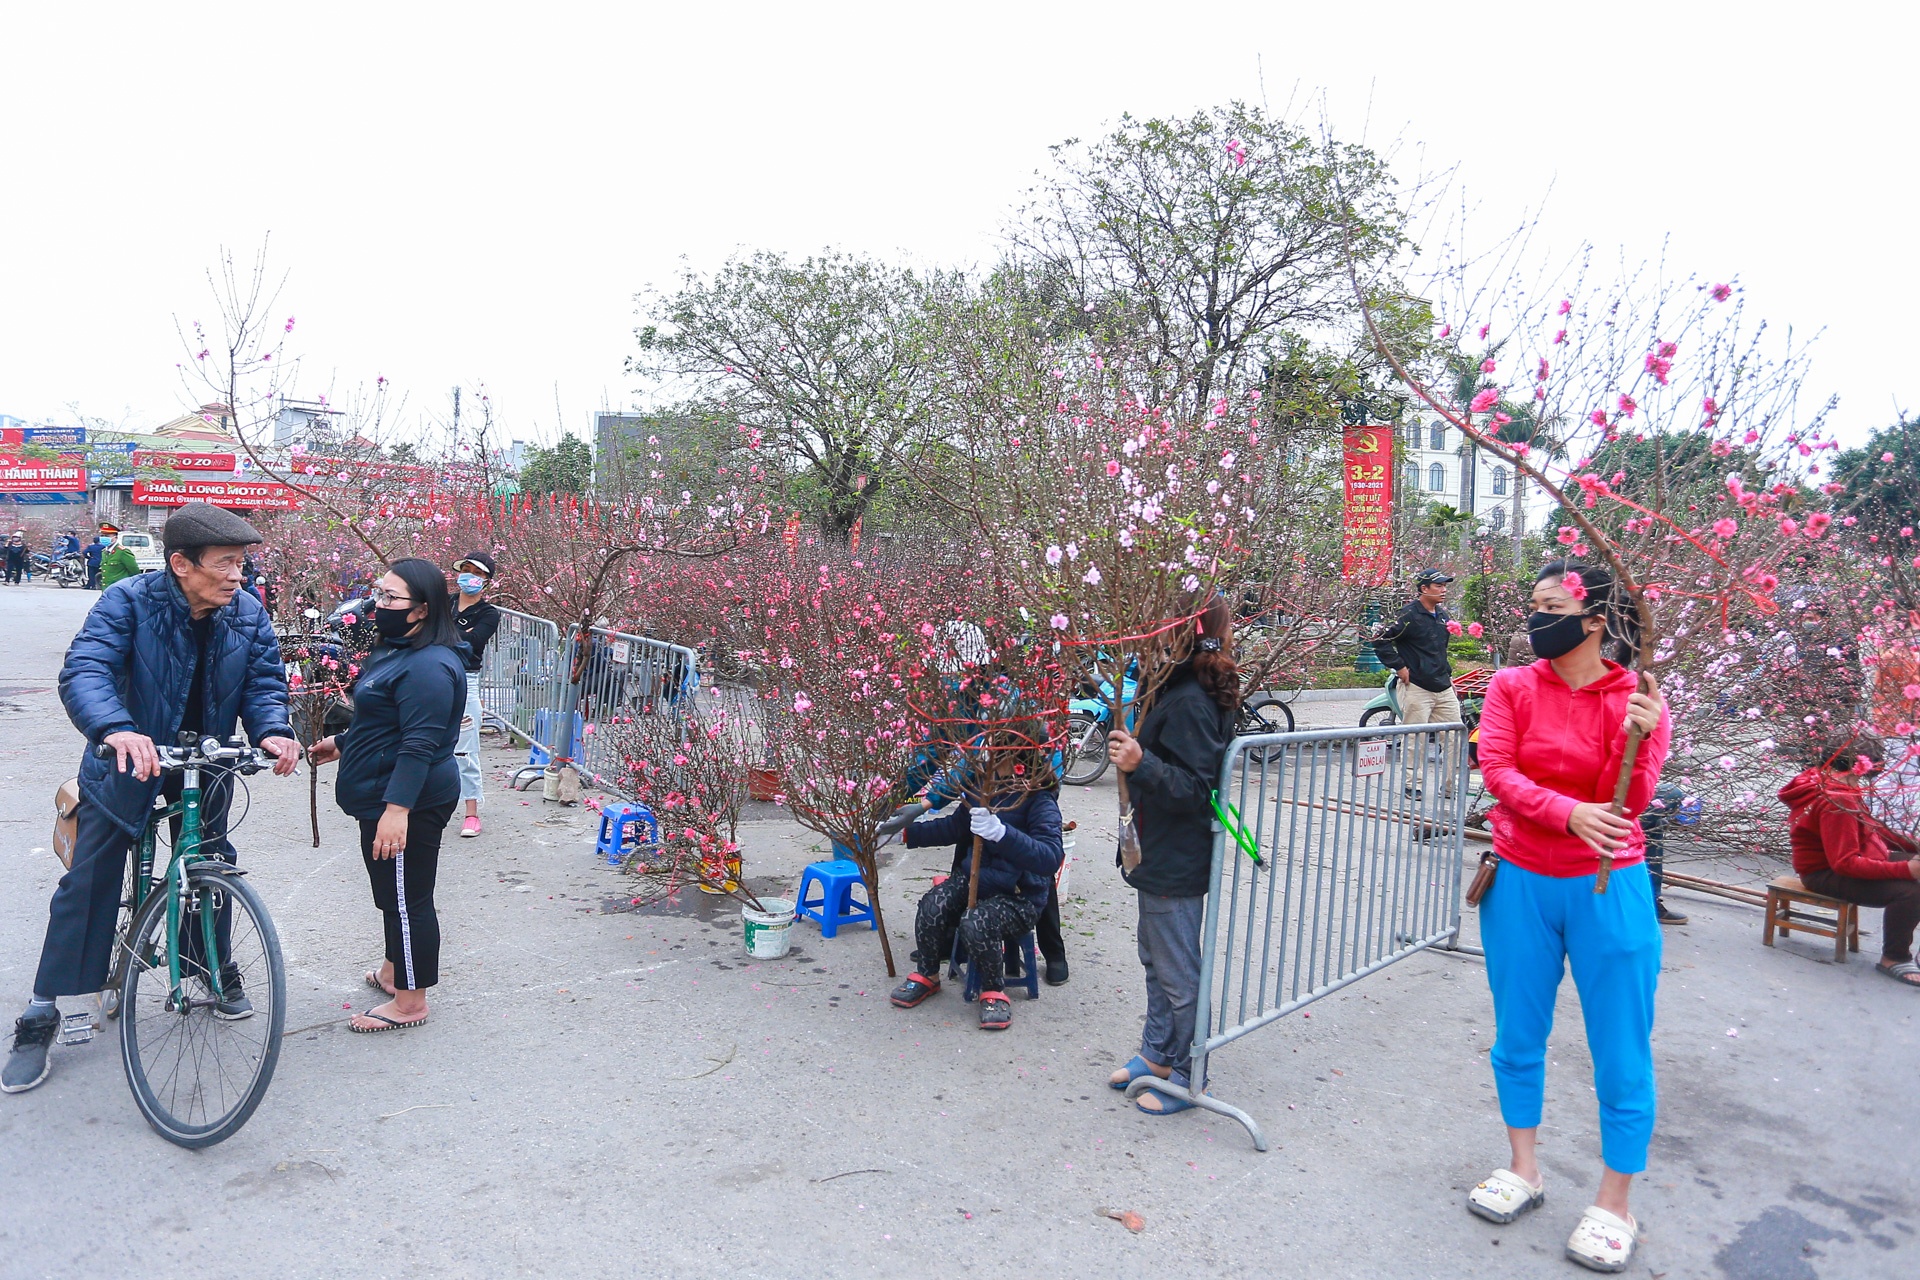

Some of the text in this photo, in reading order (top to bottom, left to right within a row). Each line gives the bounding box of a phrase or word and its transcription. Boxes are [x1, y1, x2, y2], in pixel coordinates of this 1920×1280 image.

[1351, 465, 1384, 480] 3-2
[188, 485, 225, 495] LONG
[227, 486, 268, 496] MOTO
